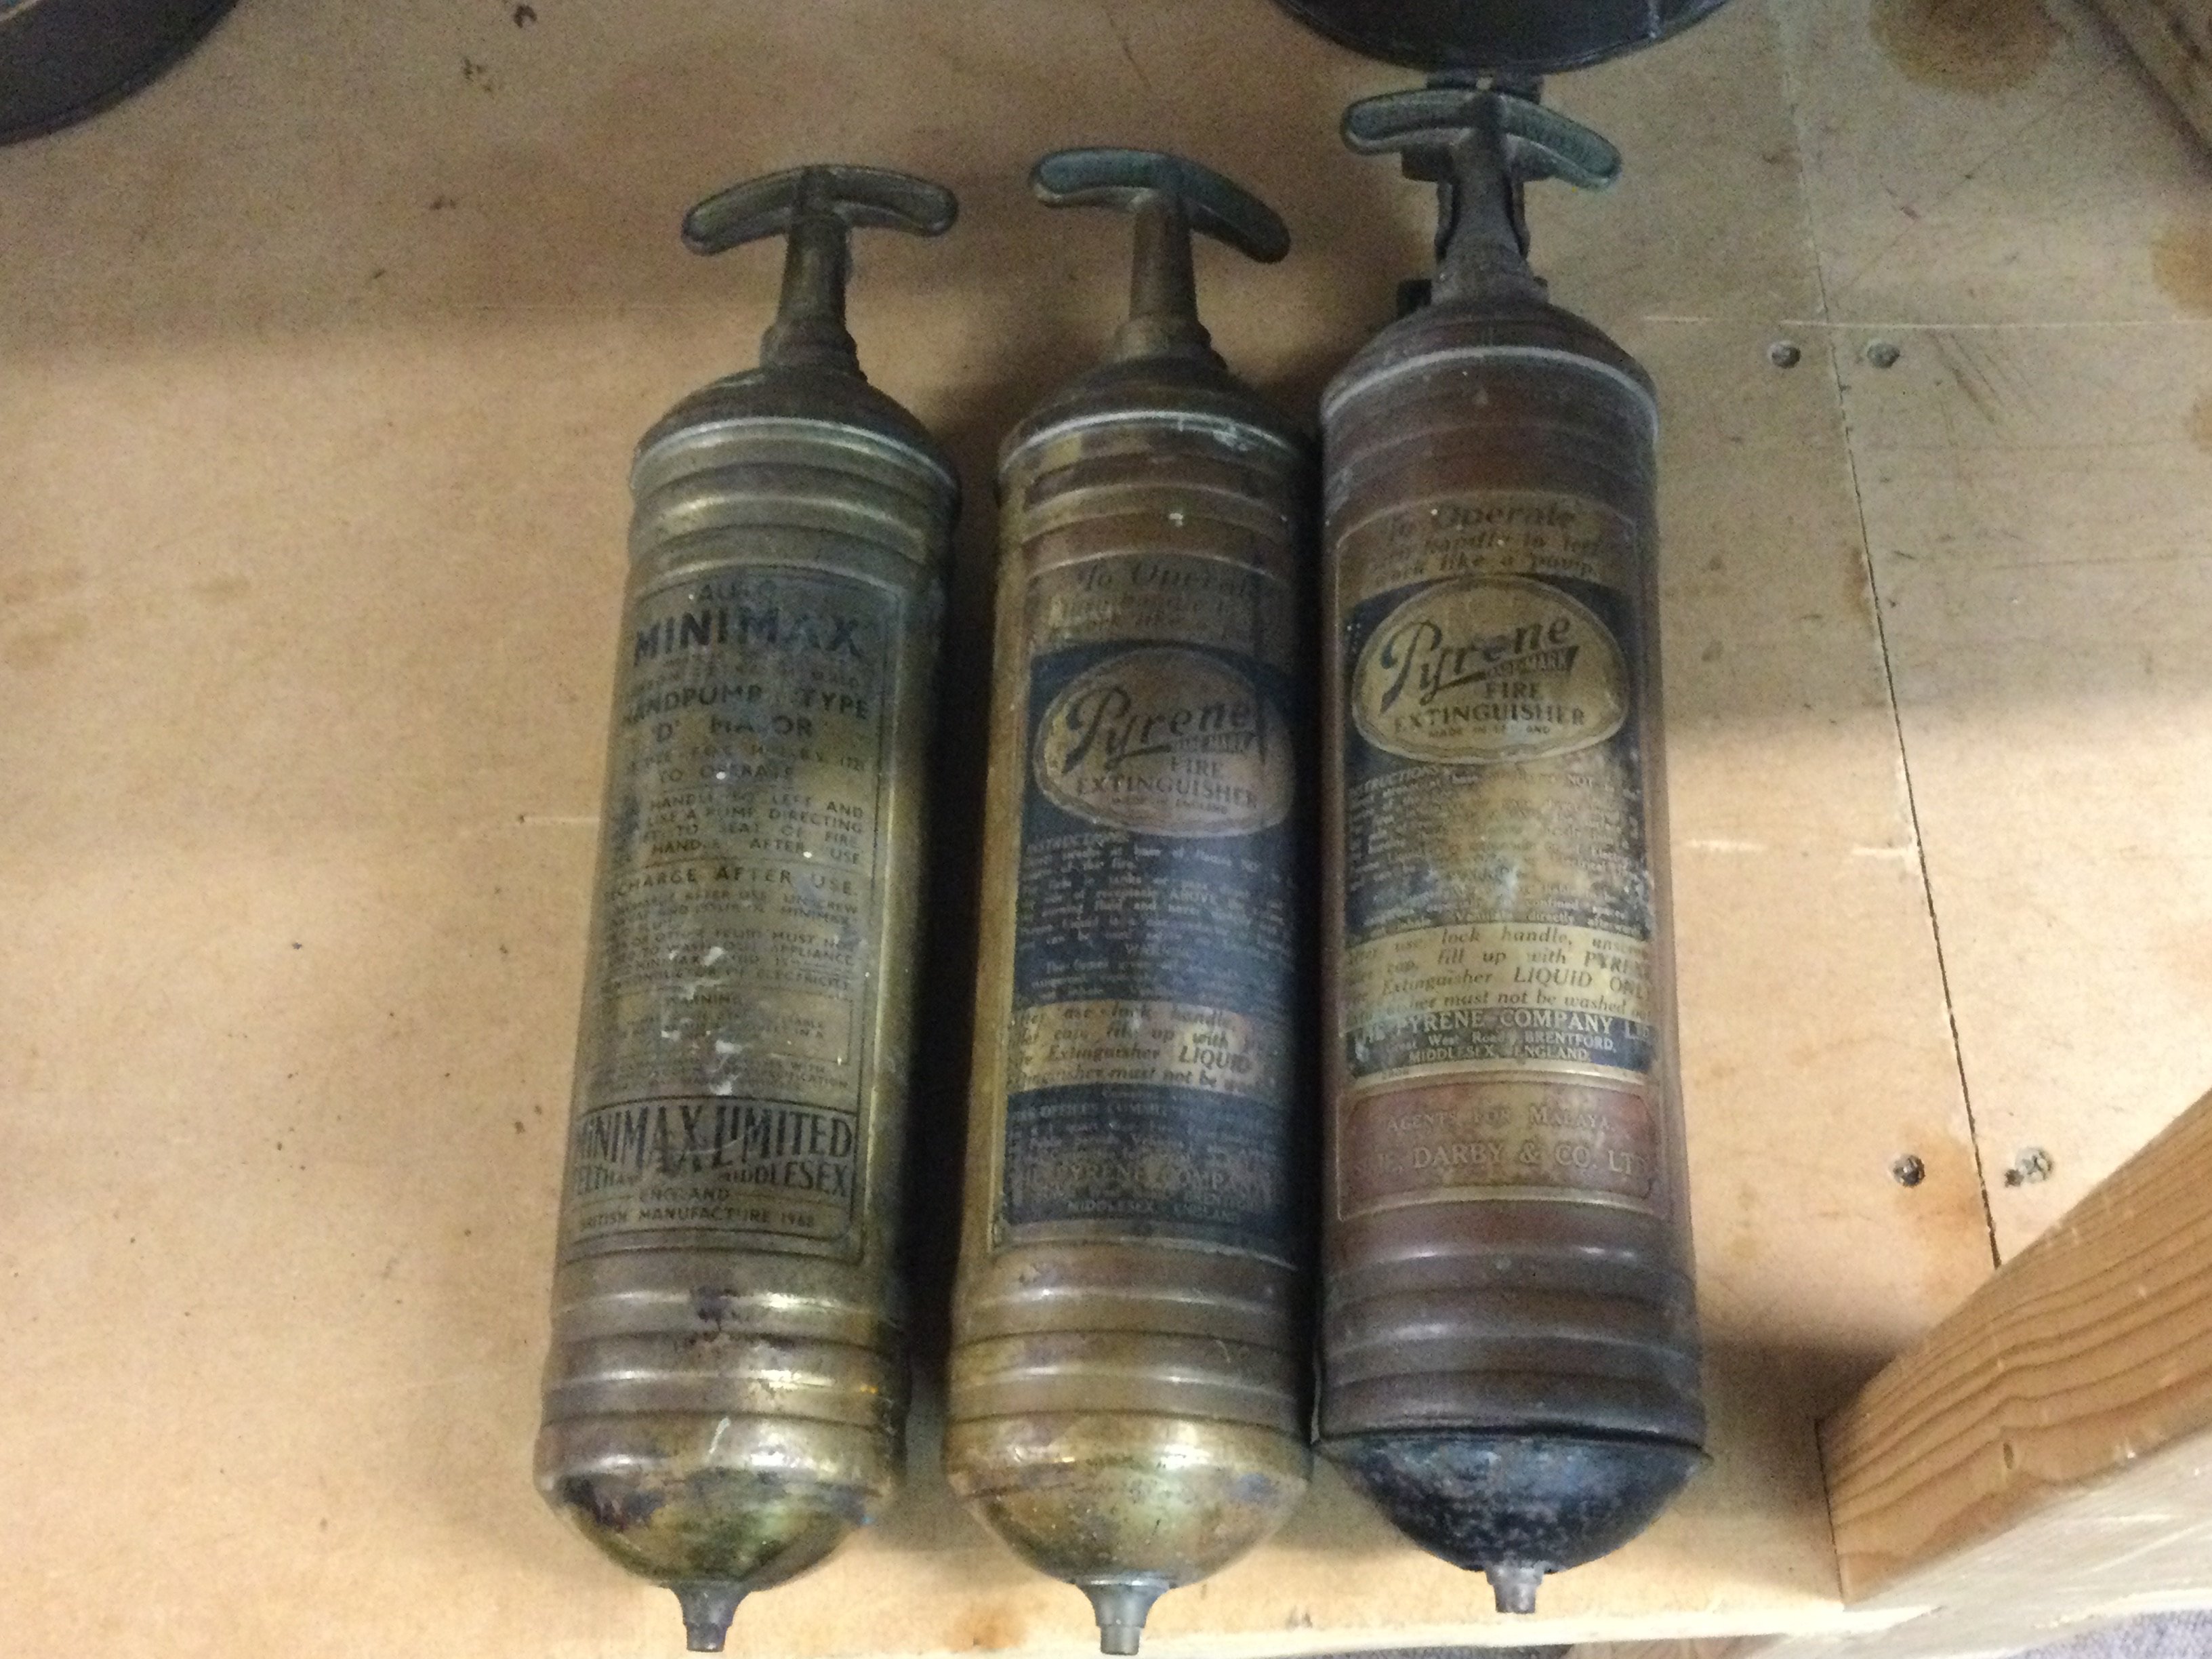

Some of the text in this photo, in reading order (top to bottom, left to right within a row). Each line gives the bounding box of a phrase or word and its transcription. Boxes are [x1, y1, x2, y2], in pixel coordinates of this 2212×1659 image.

[633, 607, 865, 668] MINIMAX
[1380, 615, 1572, 716] Pyrene
[800, 687, 869, 720] TYPE
[1484, 680, 1540, 701] FIRE
[709, 714, 813, 739] MAOR
[1062, 684, 1252, 777] Pyrene
[1394, 703, 1586, 735] EXTINGUISHER
[1076, 774, 1258, 809] EXTINGUISHER
[769, 806, 864, 834] DIRECTING
[826, 800, 865, 819] AND
[749, 837, 806, 853] AFTER
[830, 848, 861, 865] USE
[824, 831, 859, 847] FIRE
[714, 864, 793, 885] AFTER
[1441, 926, 1481, 945] lock
[1437, 947, 1465, 965] fill
[1481, 950, 1507, 966] up
[1513, 965, 1594, 988] LIQUID
[1443, 991, 1489, 1008] must
[1496, 989, 1528, 1005] not
[1535, 989, 1557, 1006] be
[1498, 1008, 1616, 1036] COMPANY
[1179, 1044, 1253, 1074] LIQUID
[580, 1105, 853, 1178] MINIMAX LIMITED
[1412, 1142, 1506, 1170] DARBY
[1519, 1143, 1538, 1164] &
[717, 1160, 850, 1198] MIDDLESEX
[638, 1206, 772, 1224] MANUFACTURE
